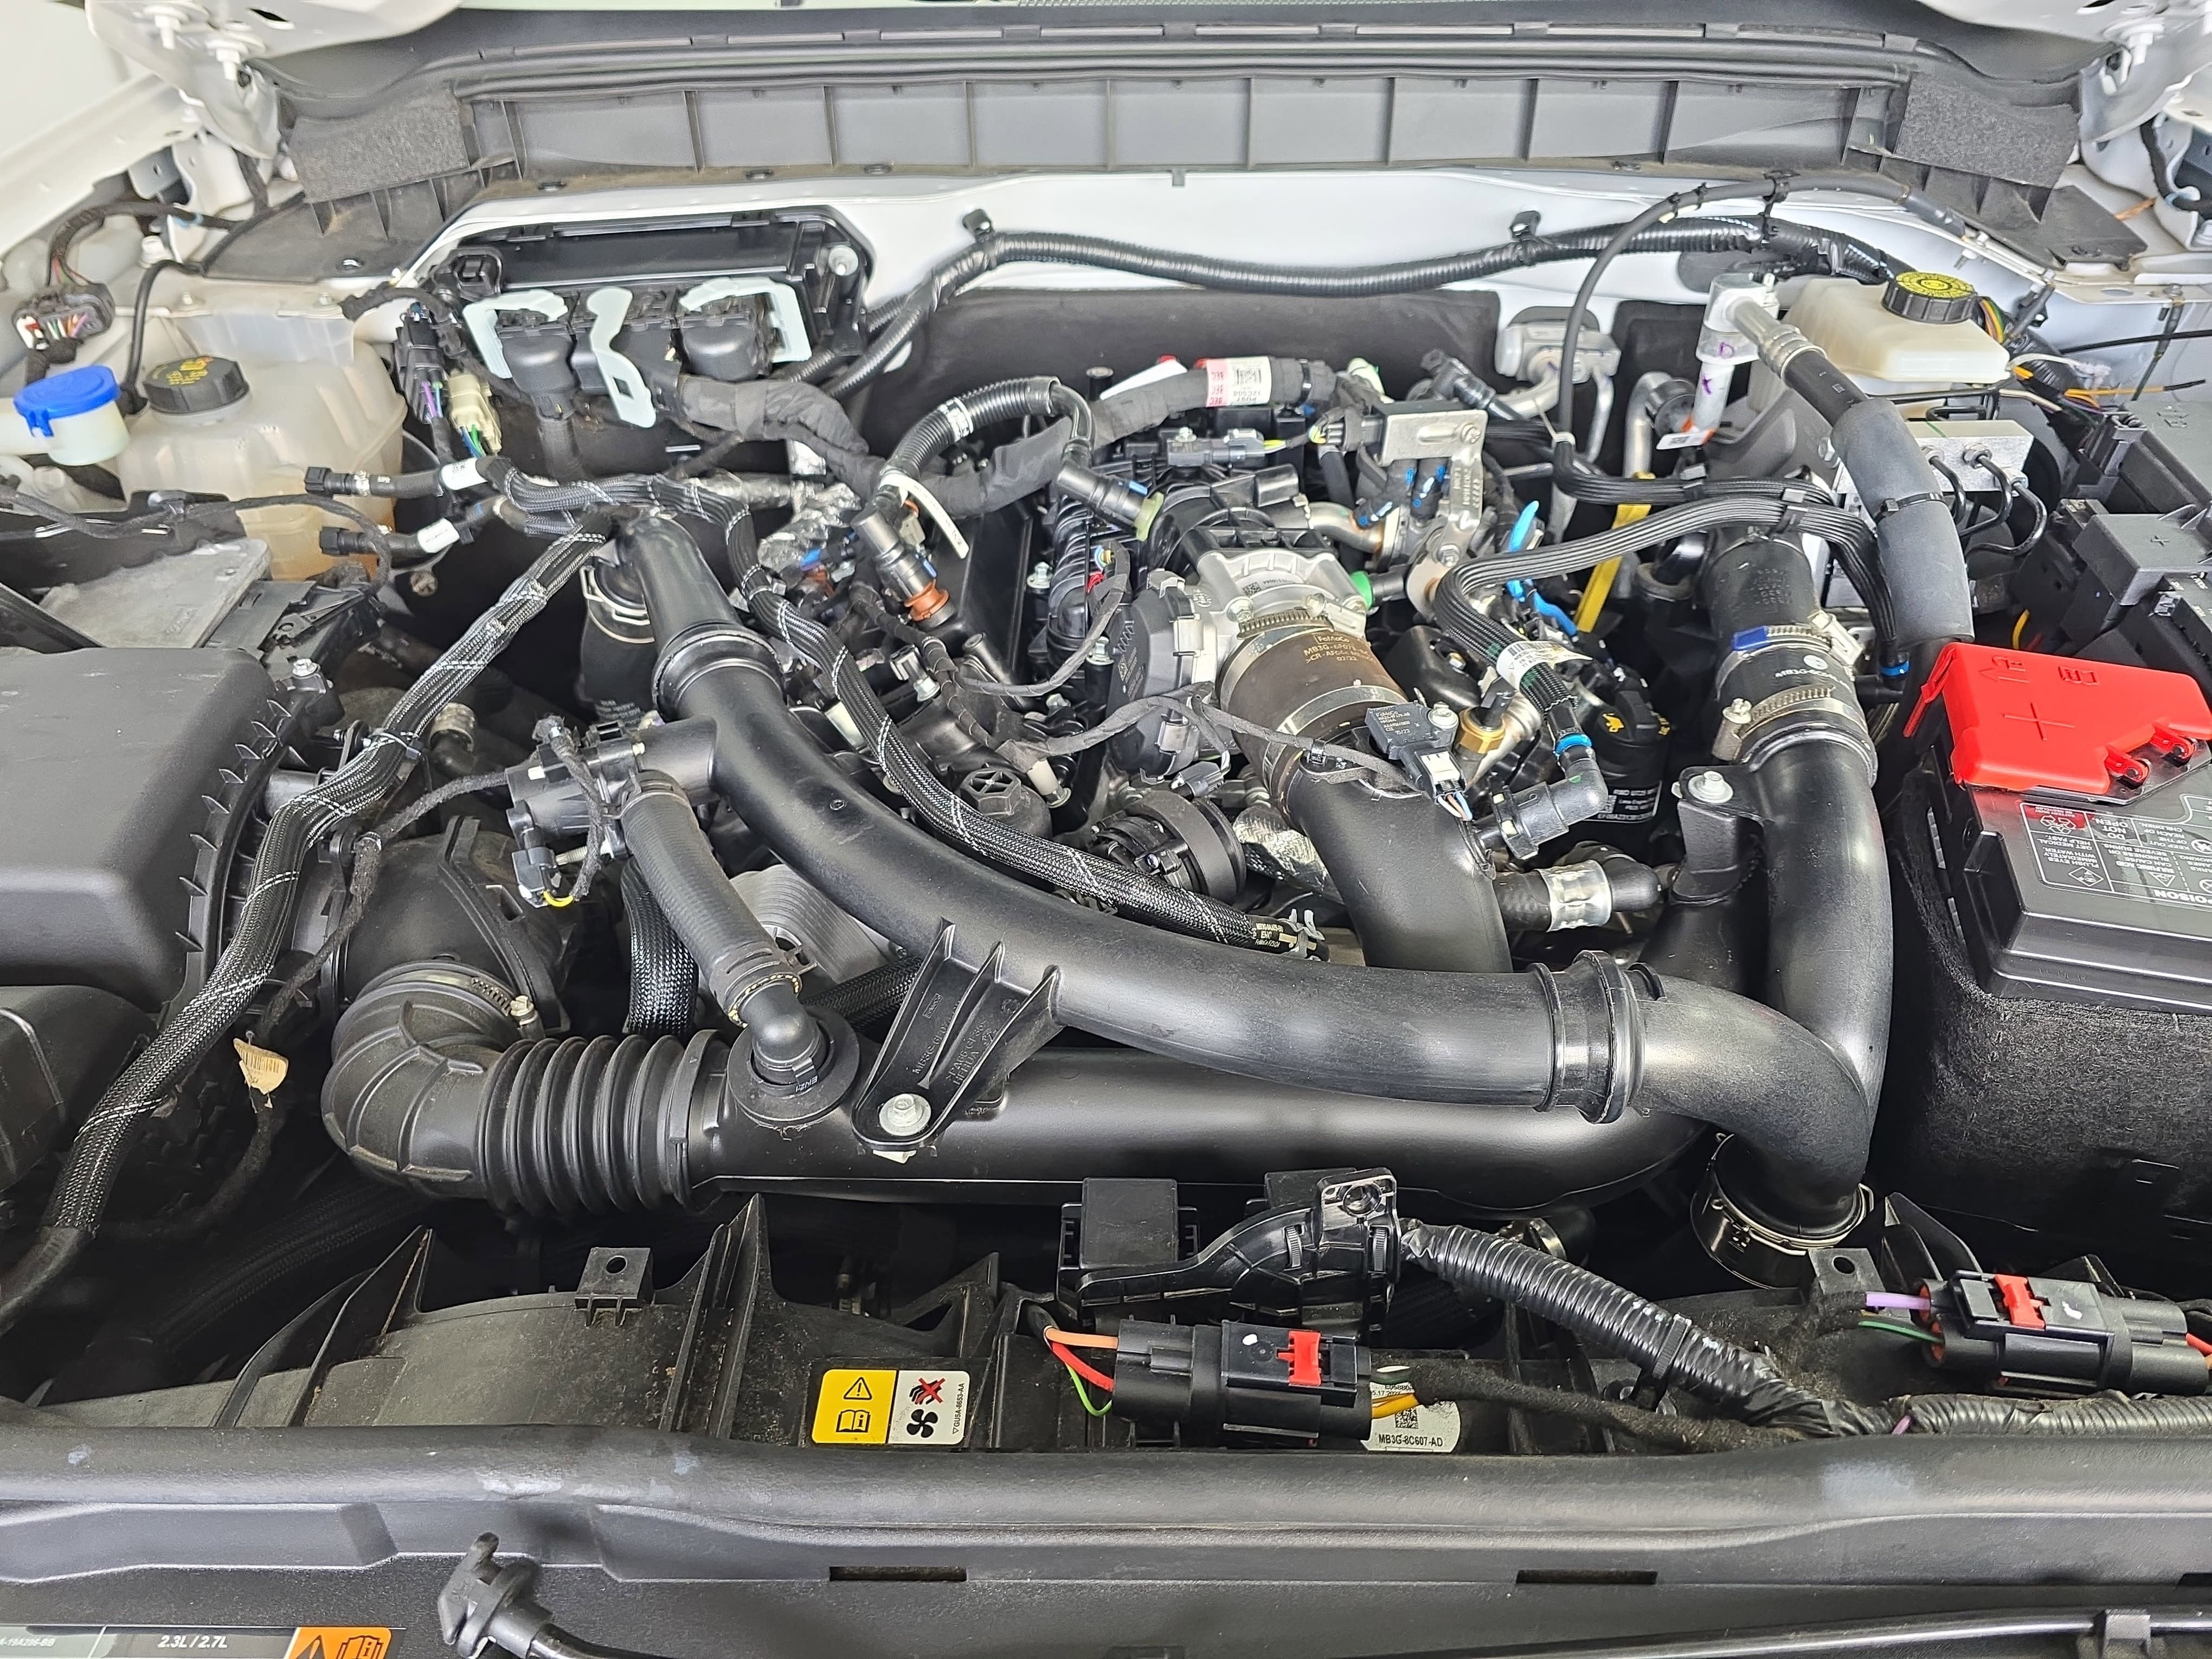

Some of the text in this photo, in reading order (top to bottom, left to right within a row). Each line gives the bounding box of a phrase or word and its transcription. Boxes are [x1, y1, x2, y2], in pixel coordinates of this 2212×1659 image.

[2102, 825, 2127, 834] NOT
[2139, 822, 2183, 833] CHILDREN.
[2107, 832, 2126, 840] DO
[2157, 831, 2185, 839] REACH
[2037, 838, 2074, 848] MEDICAL
[2042, 847, 2074, 857] WATER.
[2122, 852, 2170, 862] BLINDNESS
[2133, 848, 2168, 857] SEVERE
[2043, 852, 2098, 864] IMMEDIATELY
[2047, 857, 2100, 869] FLUSH EYES
[2124, 857, 2153, 865] CAUSE
[2136, 864, 2174, 873] SULFURIC
[953, 1382, 965, 1427] GU5A-8653-AA
[1378, 1434, 1443, 1446] MB3G-8C607-AD
[158, 1635, 228, 1648] 2.3L / 2.7L
